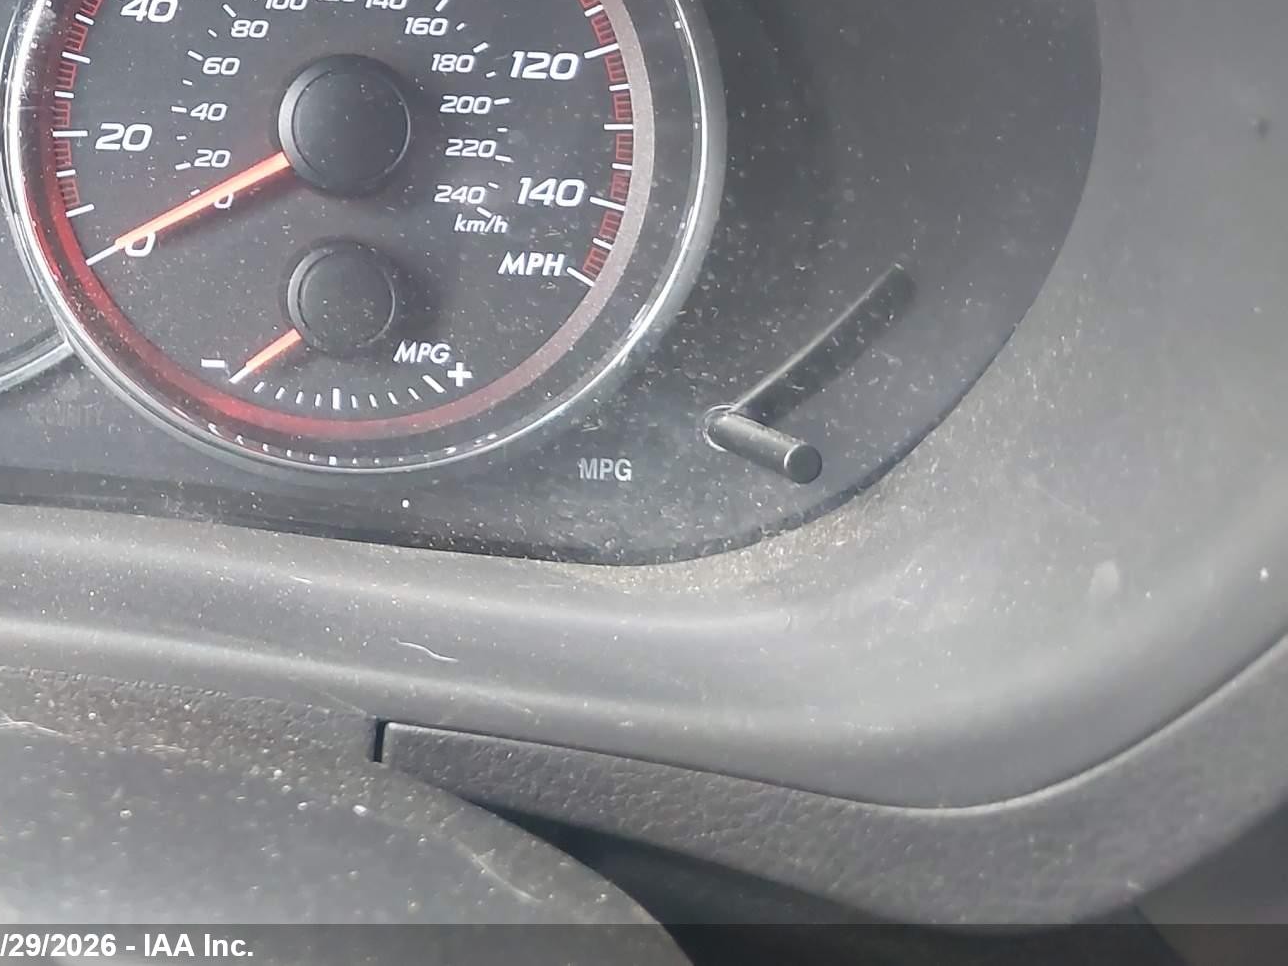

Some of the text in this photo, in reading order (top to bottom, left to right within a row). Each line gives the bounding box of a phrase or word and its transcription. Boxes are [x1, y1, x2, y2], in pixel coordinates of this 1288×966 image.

[231, 20, 268, 37] 80
[405, 17, 448, 35] 160
[203, 57, 240, 75] 60
[432, 54, 475, 72] 180
[511, 51, 579, 80] 120
[190, 103, 227, 121] 40
[440, 96, 491, 114] 200
[95, 123, 152, 151] 20
[446, 139, 496, 158] 220
[194, 150, 230, 167] 20
[435, 185, 485, 204] 240
[518, 178, 584, 206] 140
[455, 214, 508, 233] km/h
[498, 252, 564, 276] MPH
[394, 342, 450, 364] MPG
[579, 459, 631, 481] MPG
